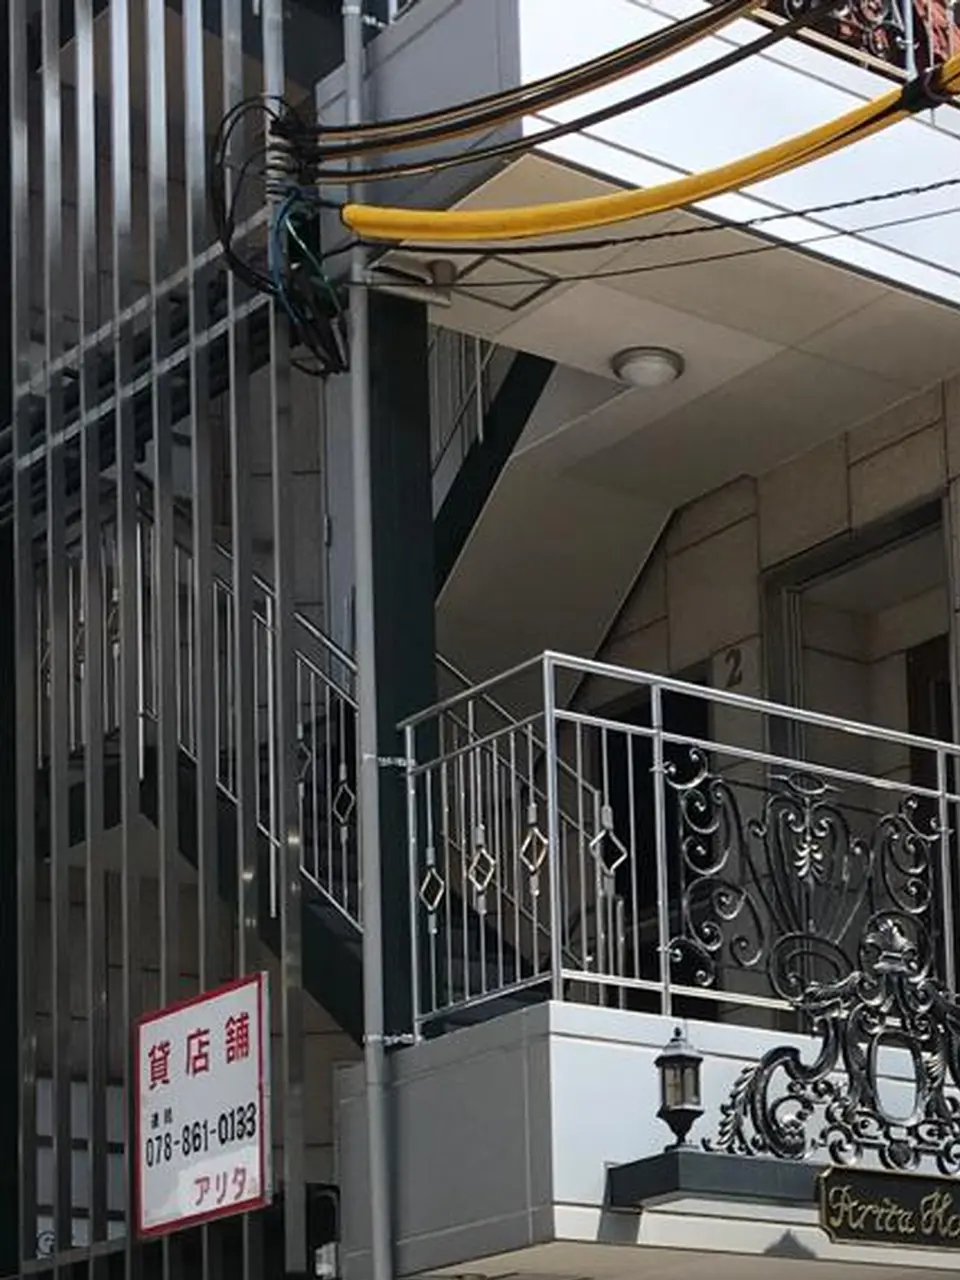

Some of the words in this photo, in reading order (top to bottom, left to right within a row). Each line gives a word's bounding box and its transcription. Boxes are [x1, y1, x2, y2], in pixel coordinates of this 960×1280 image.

[725, 648, 742, 687] 2
[148, 1013, 250, 1089] 貸店舗
[145, 1102, 257, 1168] 078-861-0133
[194, 1166, 247, 1206] アリタ
[829, 1185, 915, 1234] Arita
